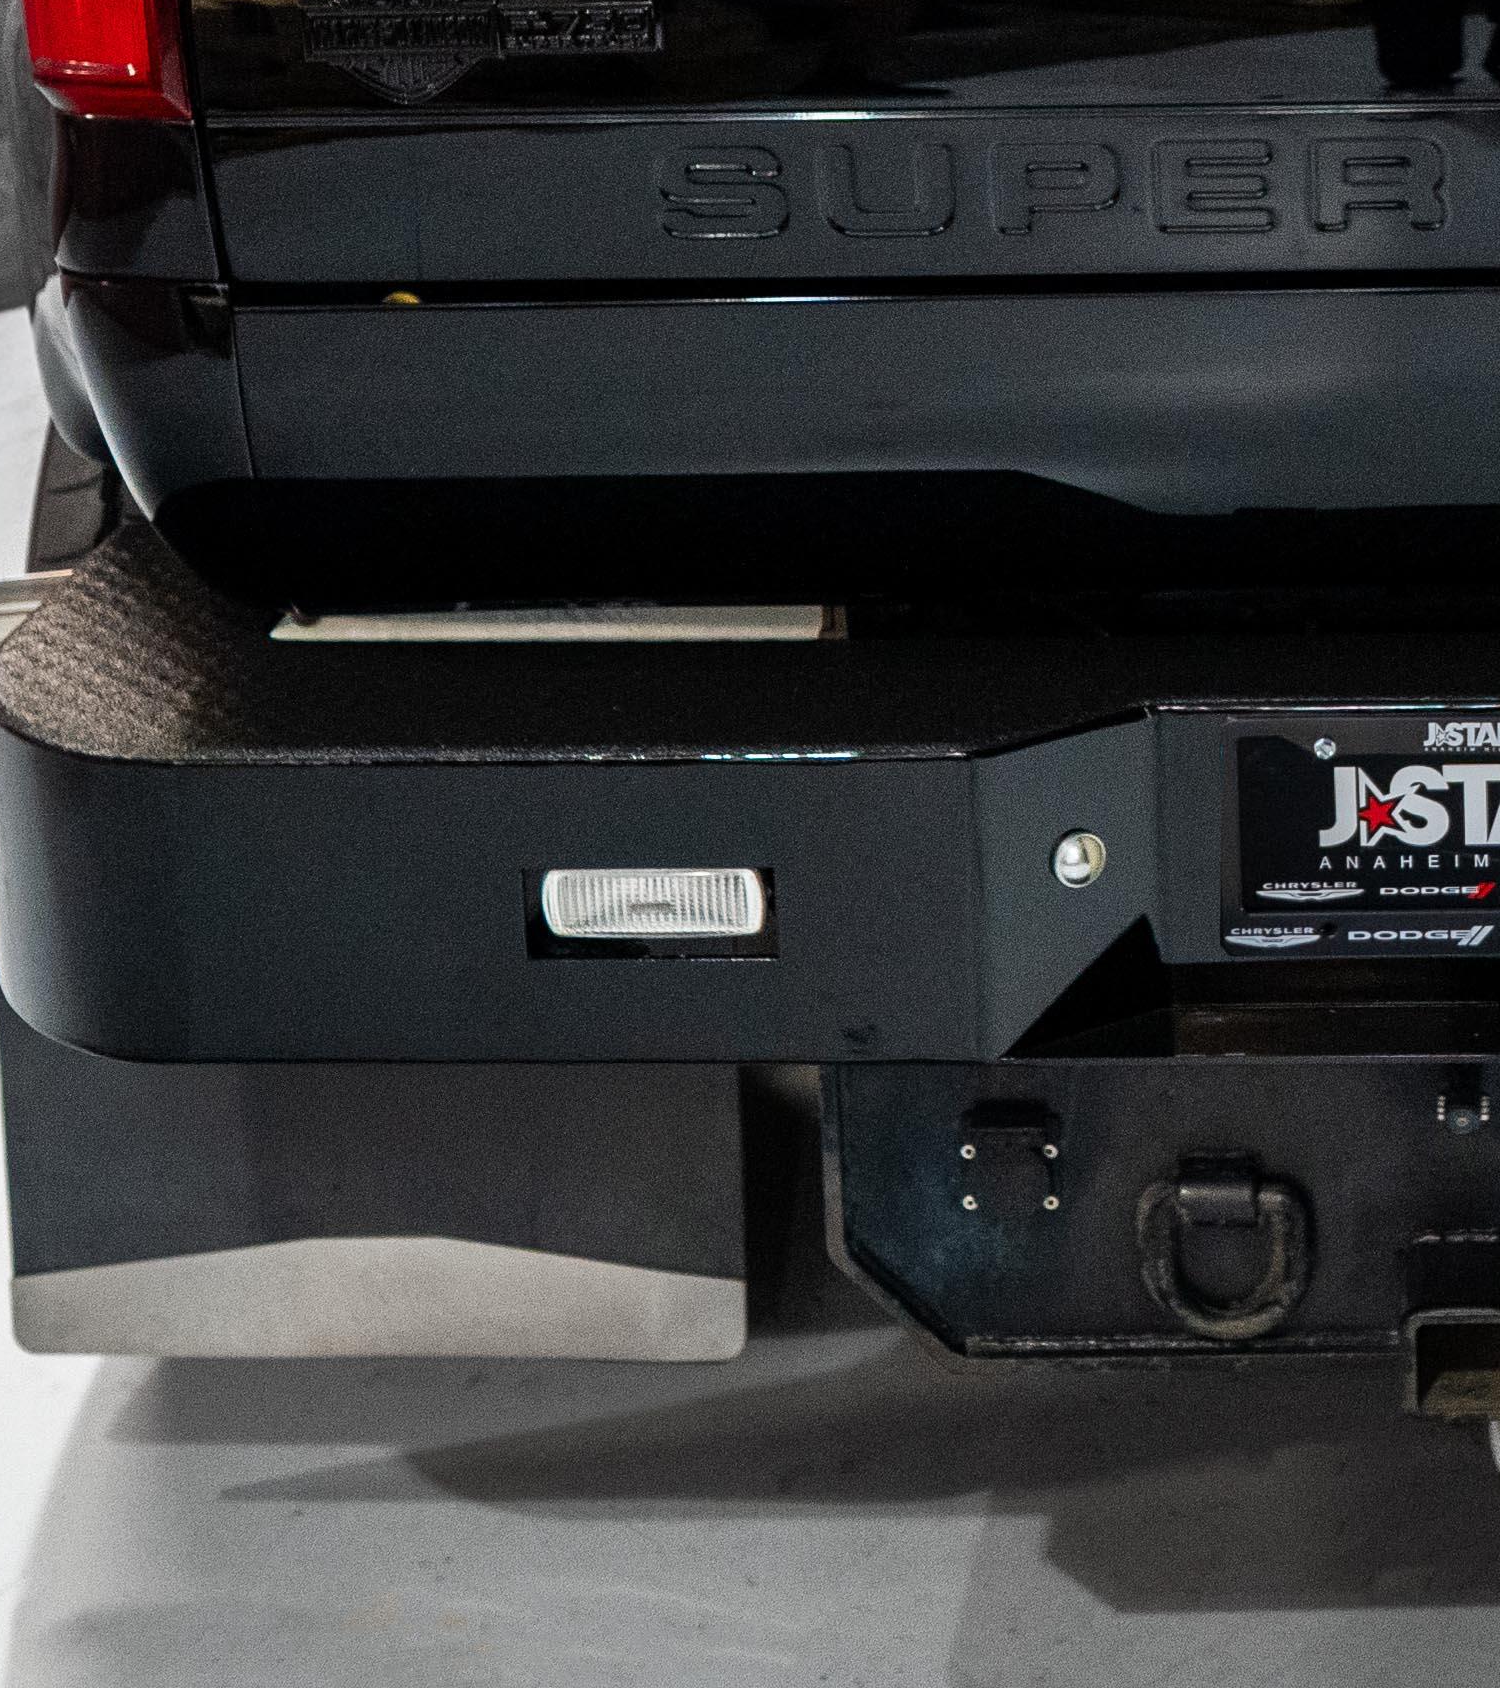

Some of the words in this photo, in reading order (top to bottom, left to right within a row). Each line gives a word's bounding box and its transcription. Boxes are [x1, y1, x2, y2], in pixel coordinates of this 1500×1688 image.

[654, 136, 1455, 240] SUPER
[1318, 854, 1490, 870] ANAHEIM
[1262, 881, 1358, 890] CHRYSLER
[1379, 886, 1481, 895] DODGE
[1230, 926, 1315, 935] CHRYSLER
[1347, 929, 1472, 941] DODGE
